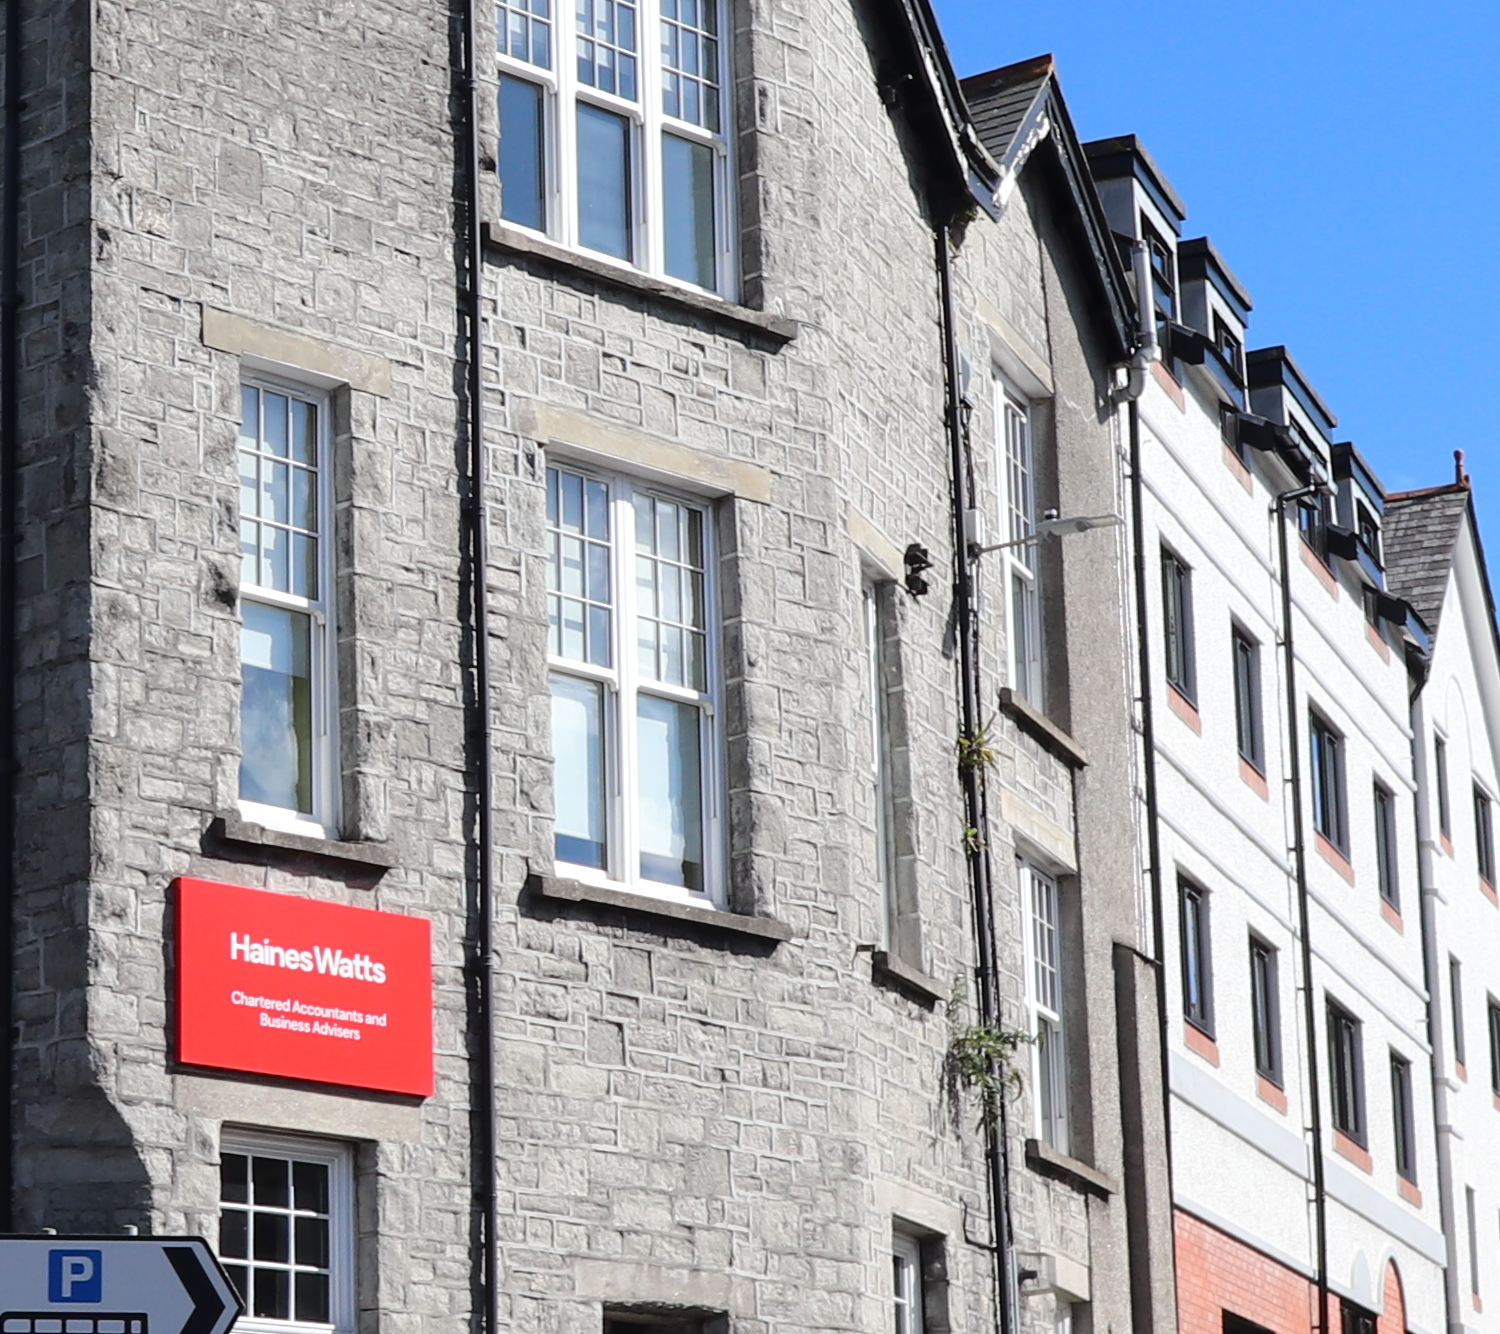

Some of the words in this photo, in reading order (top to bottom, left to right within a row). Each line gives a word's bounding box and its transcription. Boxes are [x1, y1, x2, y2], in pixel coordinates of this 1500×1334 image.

[231, 990, 291, 1012] Chartered
[292, 1000, 364, 1024] Accountants
[364, 1013, 387, 1027] and
[259, 1012, 311, 1033] Business
[312, 1021, 361, 1041] Advisers
[61, 1256, 93, 1298] P
